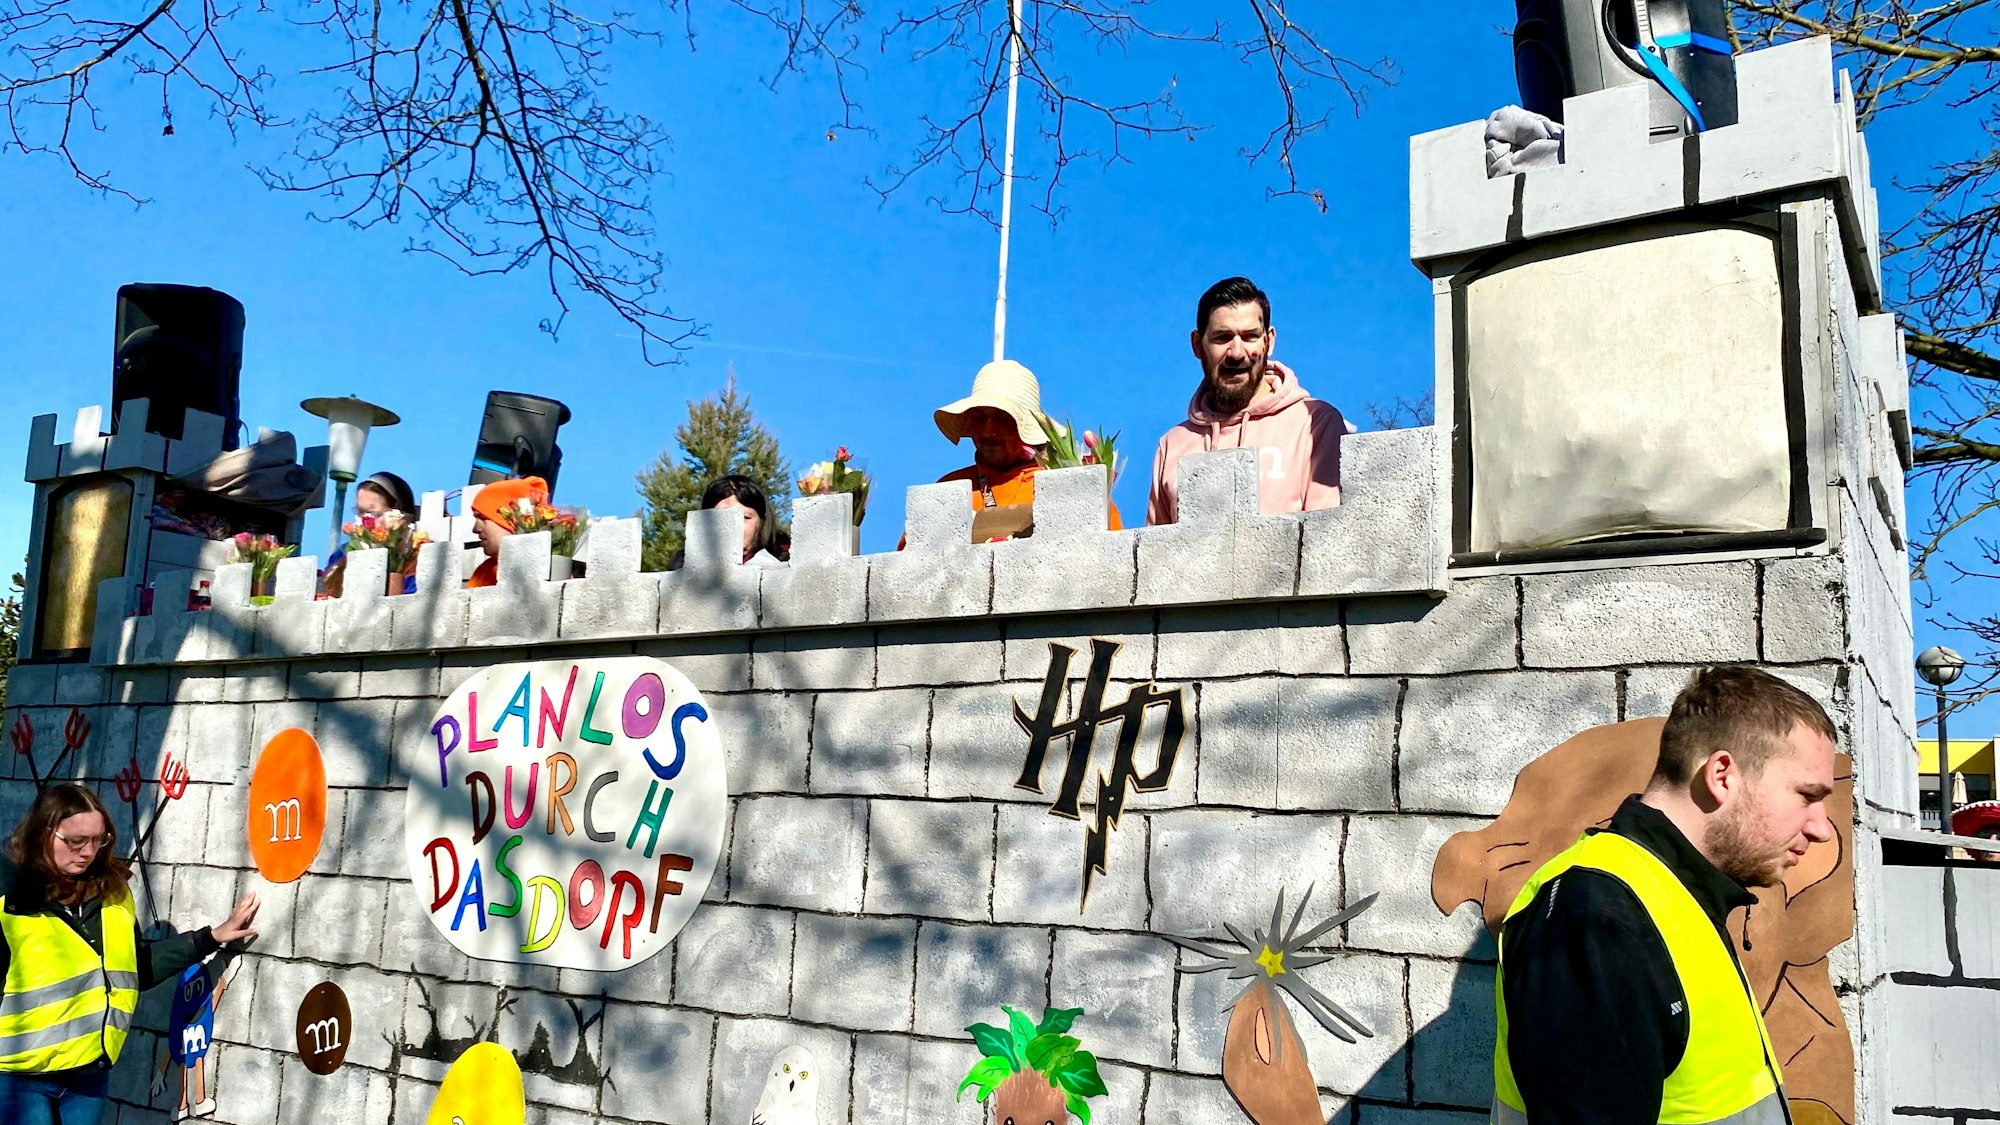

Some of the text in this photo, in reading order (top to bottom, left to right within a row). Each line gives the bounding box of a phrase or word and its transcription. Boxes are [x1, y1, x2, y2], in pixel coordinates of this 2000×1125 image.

[431, 665, 708, 788] PLANLOS
[264, 797, 302, 843] m
[465, 752, 674, 859] DURCH
[422, 835, 694, 960] DASDORF
[181, 1023, 208, 1055] m
[305, 1016, 342, 1055] m
